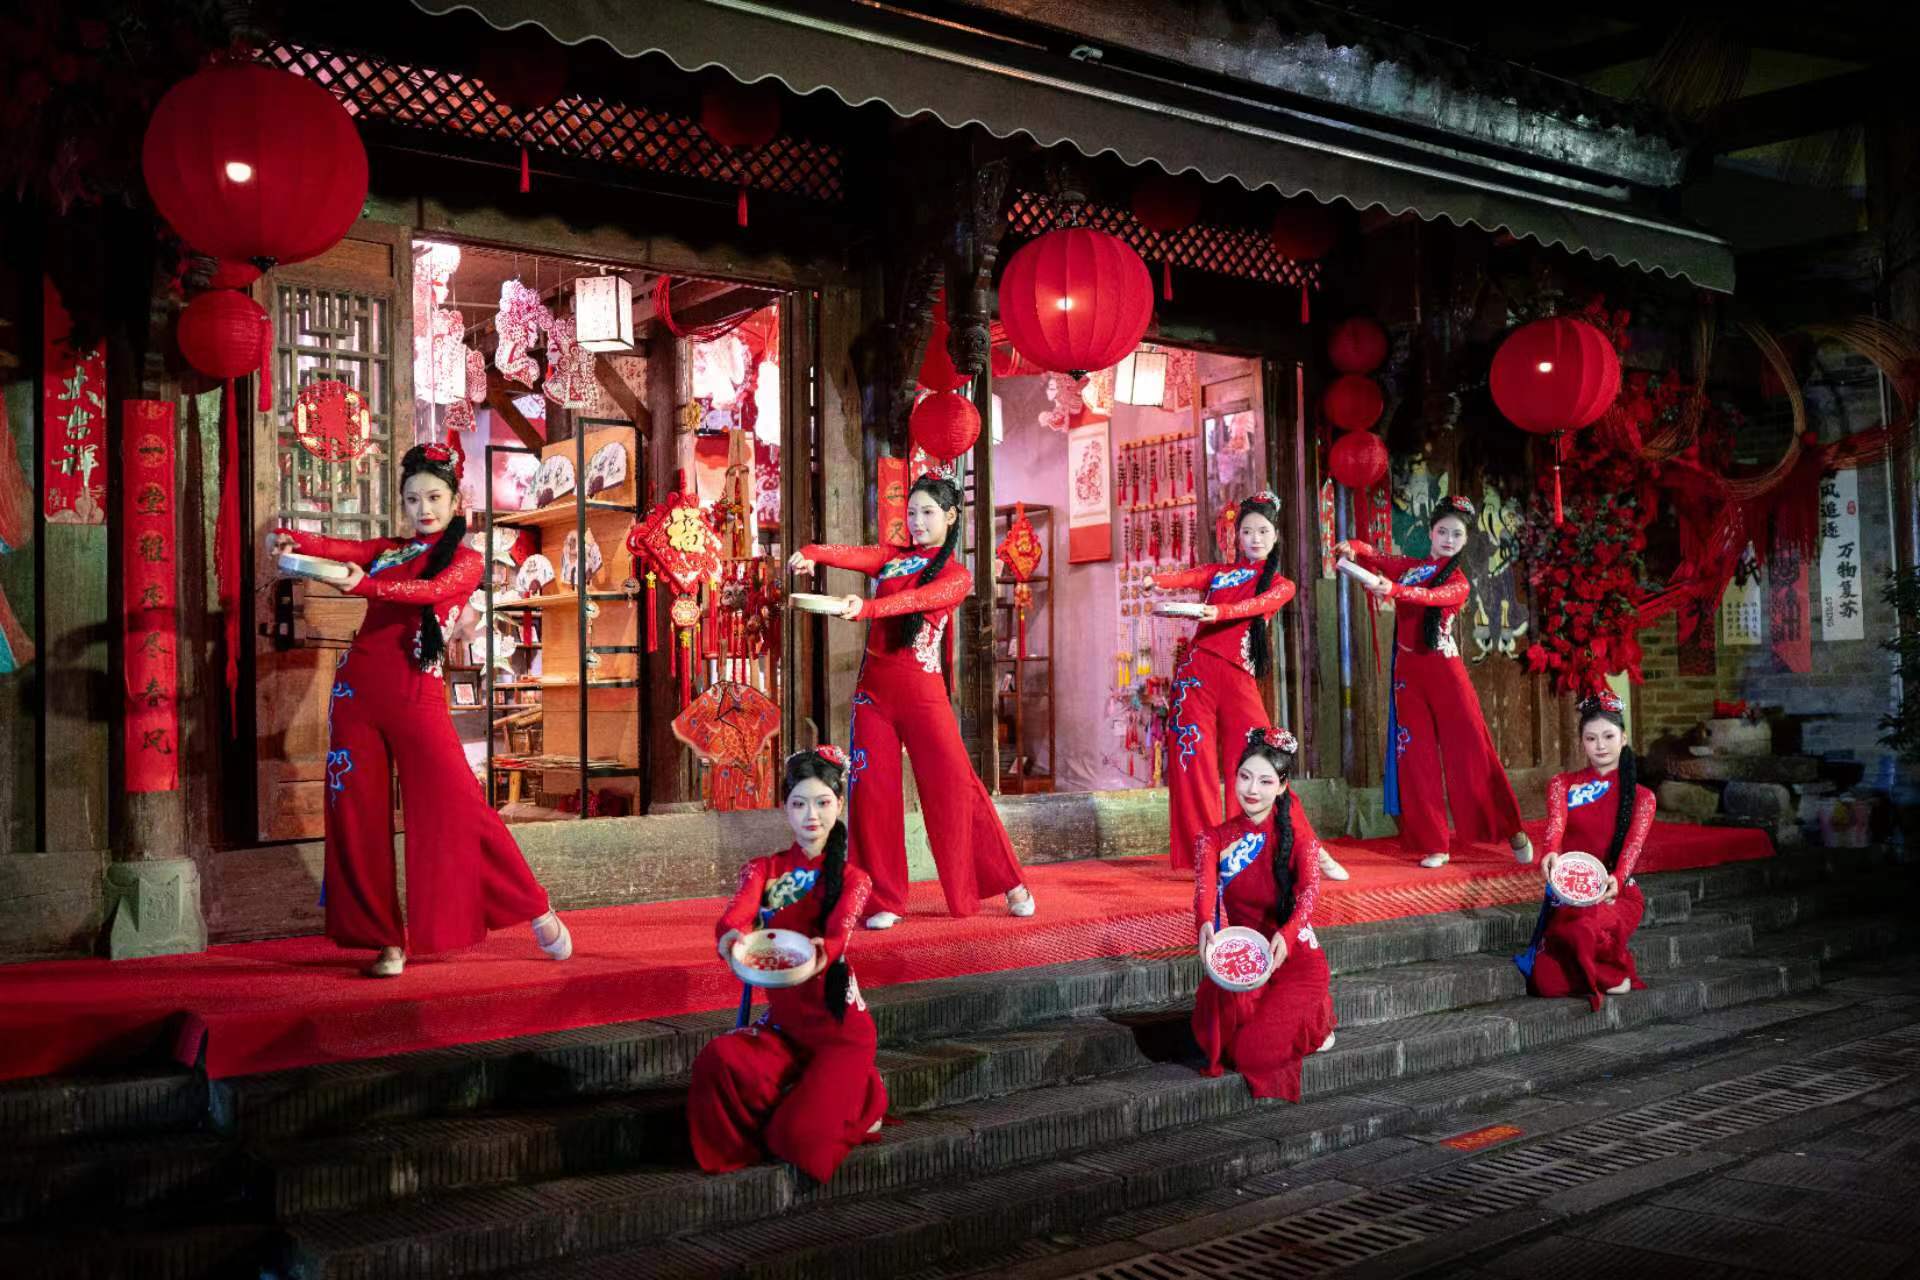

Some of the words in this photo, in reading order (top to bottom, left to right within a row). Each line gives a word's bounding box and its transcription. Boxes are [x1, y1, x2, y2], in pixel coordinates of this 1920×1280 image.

[667, 507, 707, 554] 福
[1836, 541, 1859, 619] 万物复苏
[1563, 869, 1593, 895] 福
[1221, 943, 1258, 978] 福
